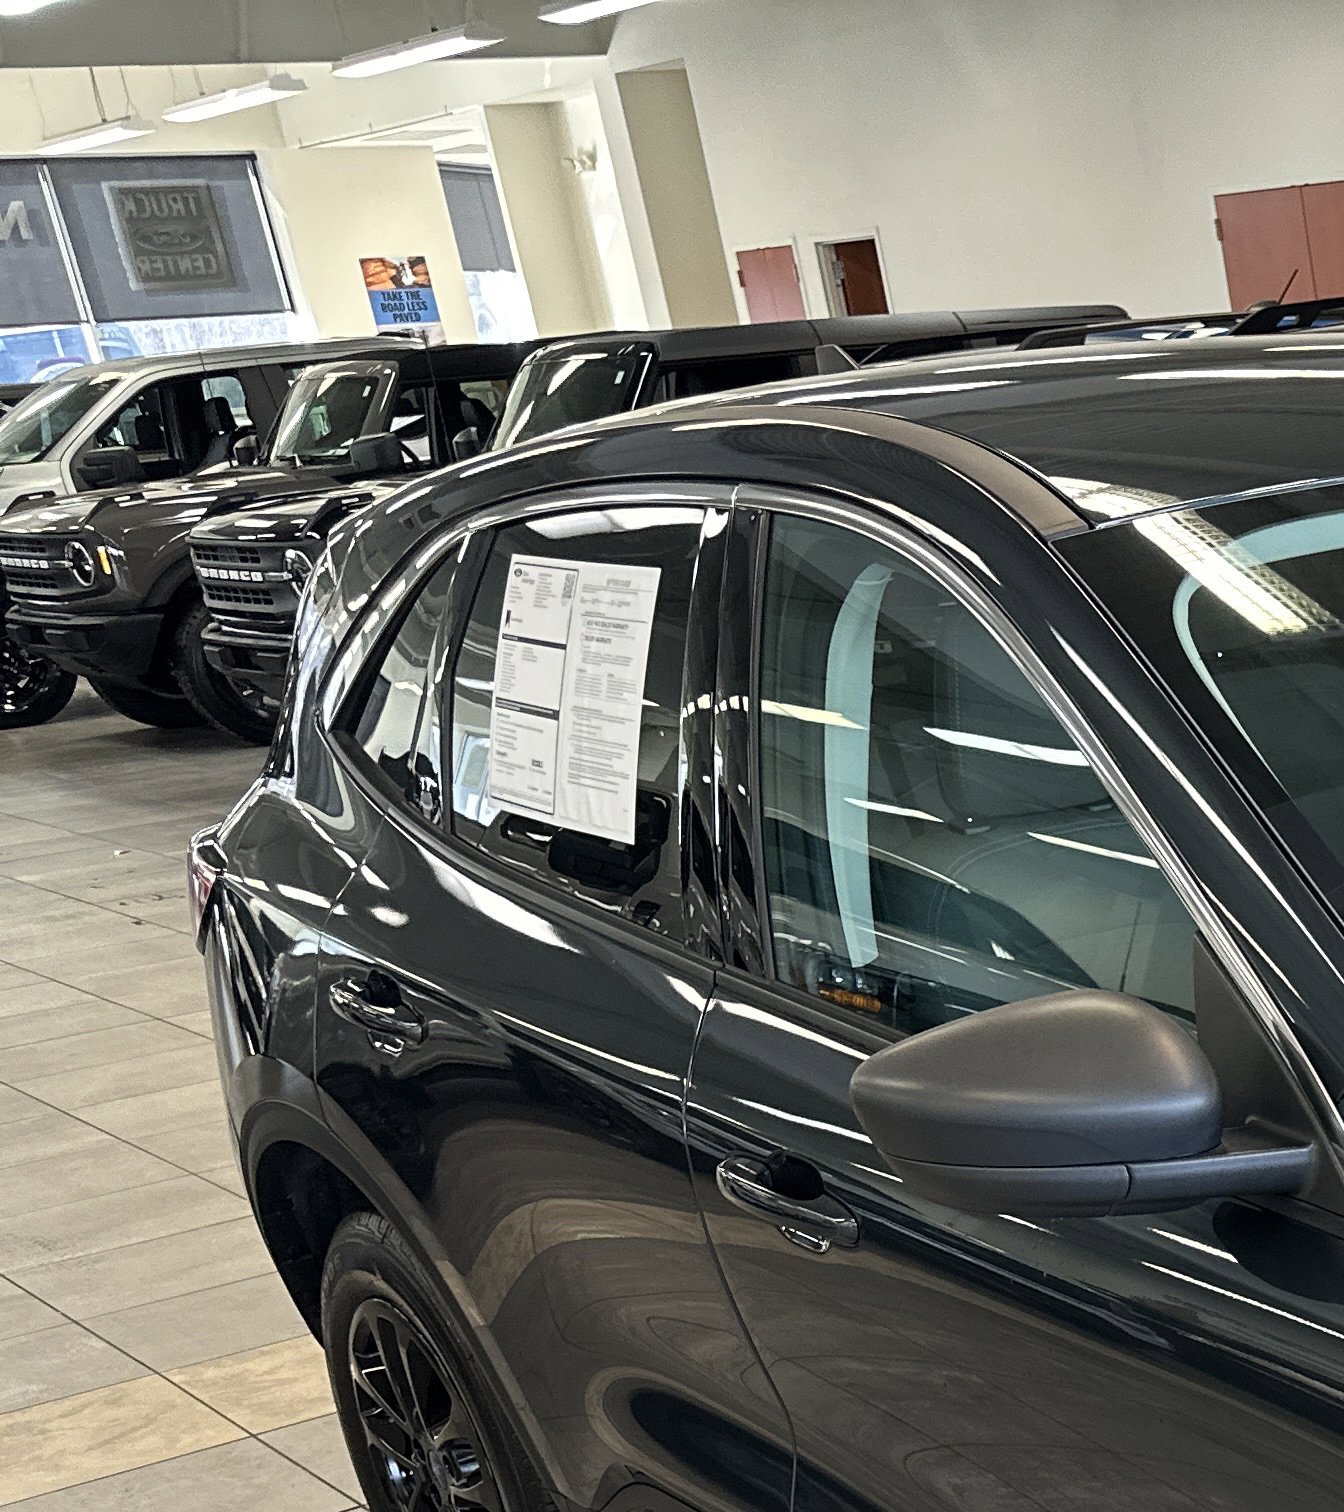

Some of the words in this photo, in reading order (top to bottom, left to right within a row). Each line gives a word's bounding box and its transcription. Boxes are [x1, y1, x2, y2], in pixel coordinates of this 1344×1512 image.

[381, 290, 404, 302] TAKE
[404, 290, 422, 301] THE
[380, 301, 406, 313] ROAD
[406, 300, 428, 312] LESS
[392, 312, 422, 323] PAVED
[199, 566, 264, 582] BRONCO
